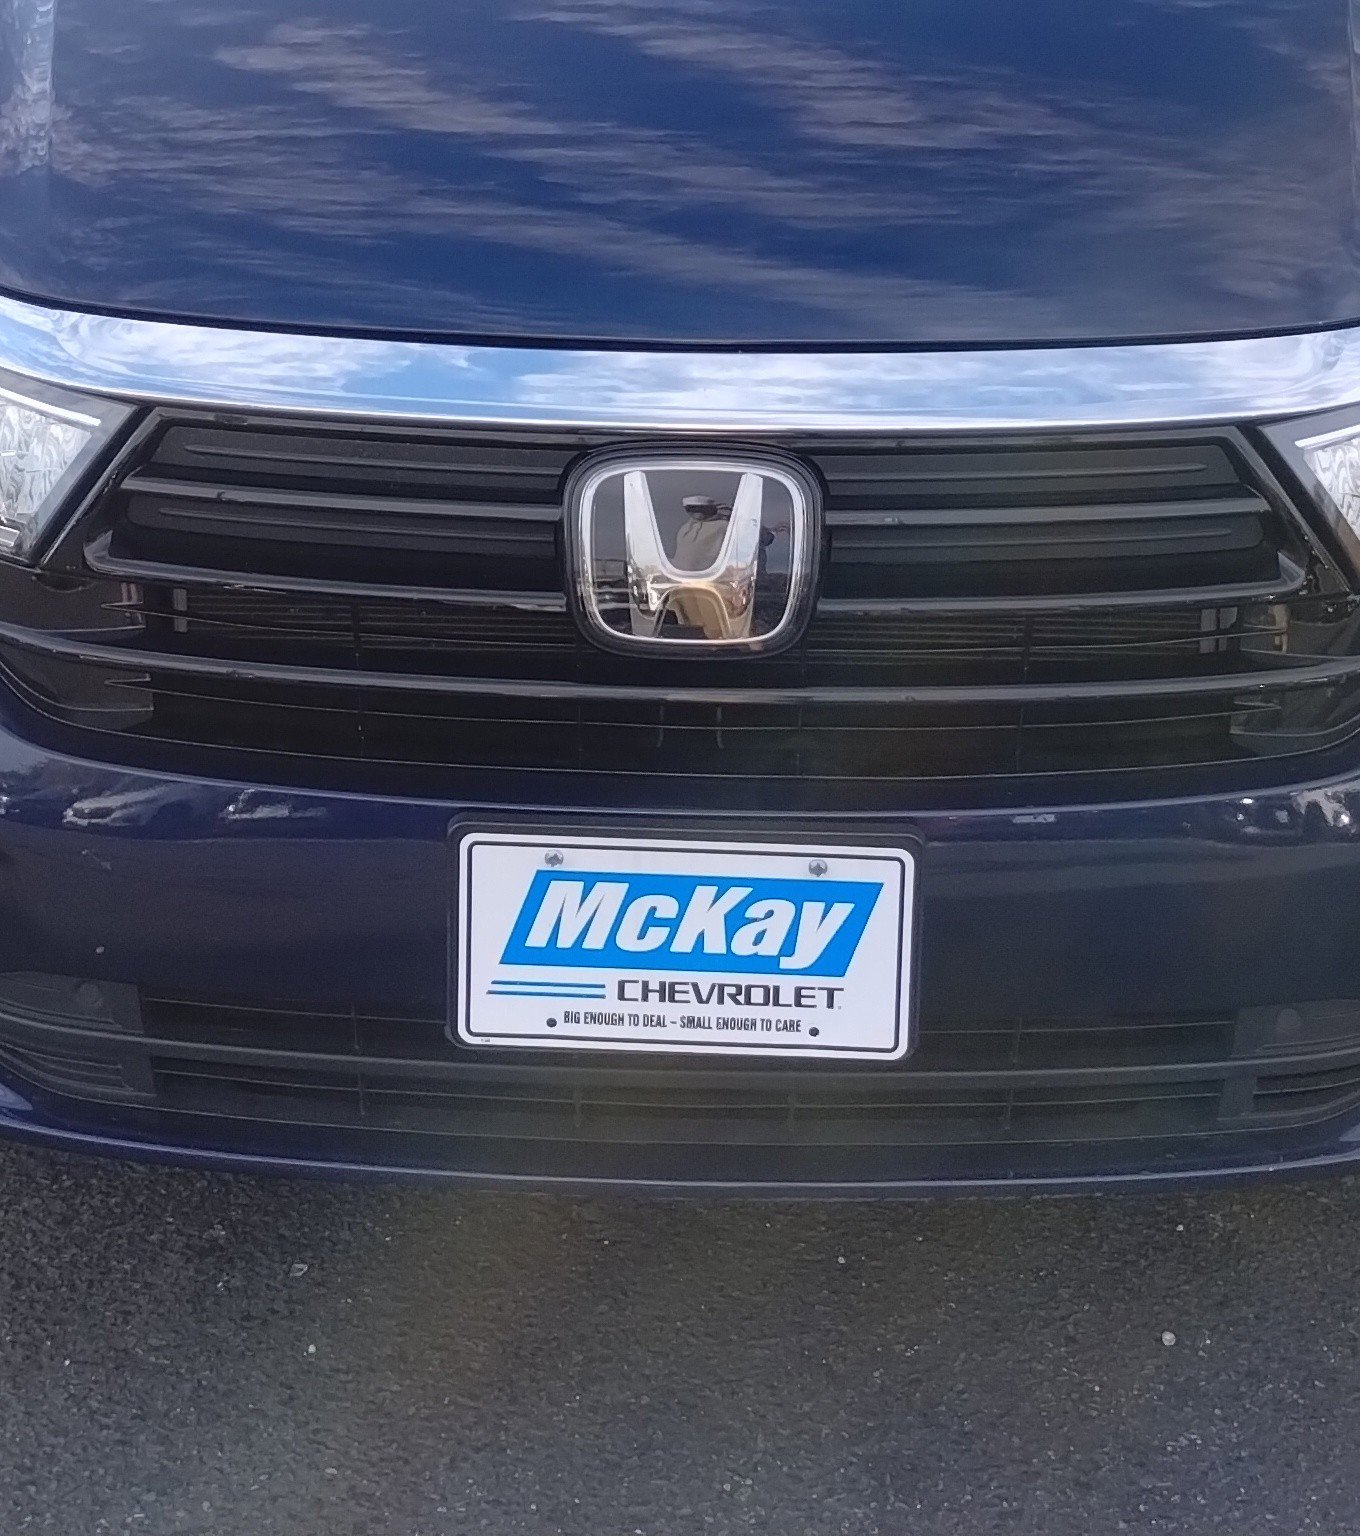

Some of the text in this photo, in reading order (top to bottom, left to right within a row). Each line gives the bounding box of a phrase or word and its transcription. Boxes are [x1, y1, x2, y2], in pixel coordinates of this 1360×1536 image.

[525, 880, 853, 970] McKay
[617, 979, 844, 1010] CHEVROLET
[564, 1010, 580, 1024] BIG
[584, 1012, 625, 1027] ENOUGH
[627, 1013, 640, 1027] TO
[642, 1014, 668, 1028] DEAL
[679, 1015, 713, 1031] SMALL
[716, 1017, 757, 1031] ENOUGH
[759, 1018, 772, 1032] TO
[775, 1019, 802, 1033] CARE
